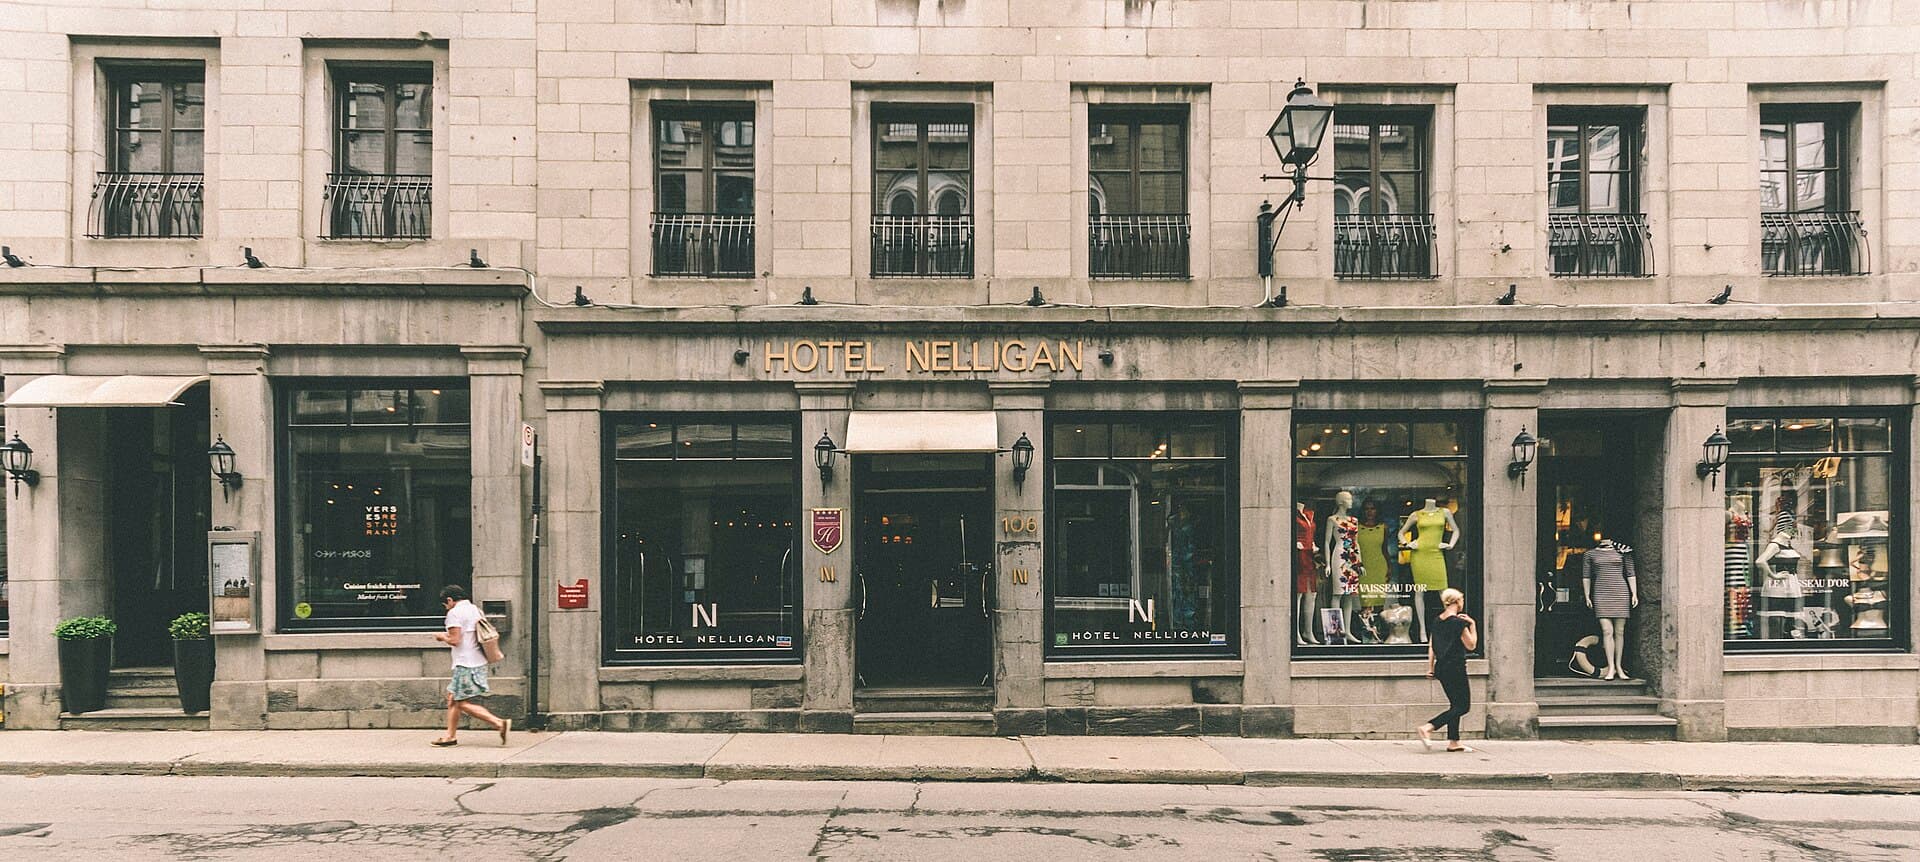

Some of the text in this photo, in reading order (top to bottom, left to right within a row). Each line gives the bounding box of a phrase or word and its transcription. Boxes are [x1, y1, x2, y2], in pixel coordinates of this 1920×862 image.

[764, 339, 1083, 373] HOTEL NELLIGAN
[365, 505, 397, 513] VERS
[1001, 515, 1038, 533] 106
[819, 565, 835, 582] N
[1012, 568, 1029, 584] N
[1345, 584, 1428, 592] LE VAISSEAU D'OR
[1827, 578, 1850, 588] D'OR
[692, 603, 717, 628] N
[1128, 598, 1153, 623] N
[697, 634, 776, 644] NELLIGAN
[1133, 631, 1210, 640] NELLIGAN
